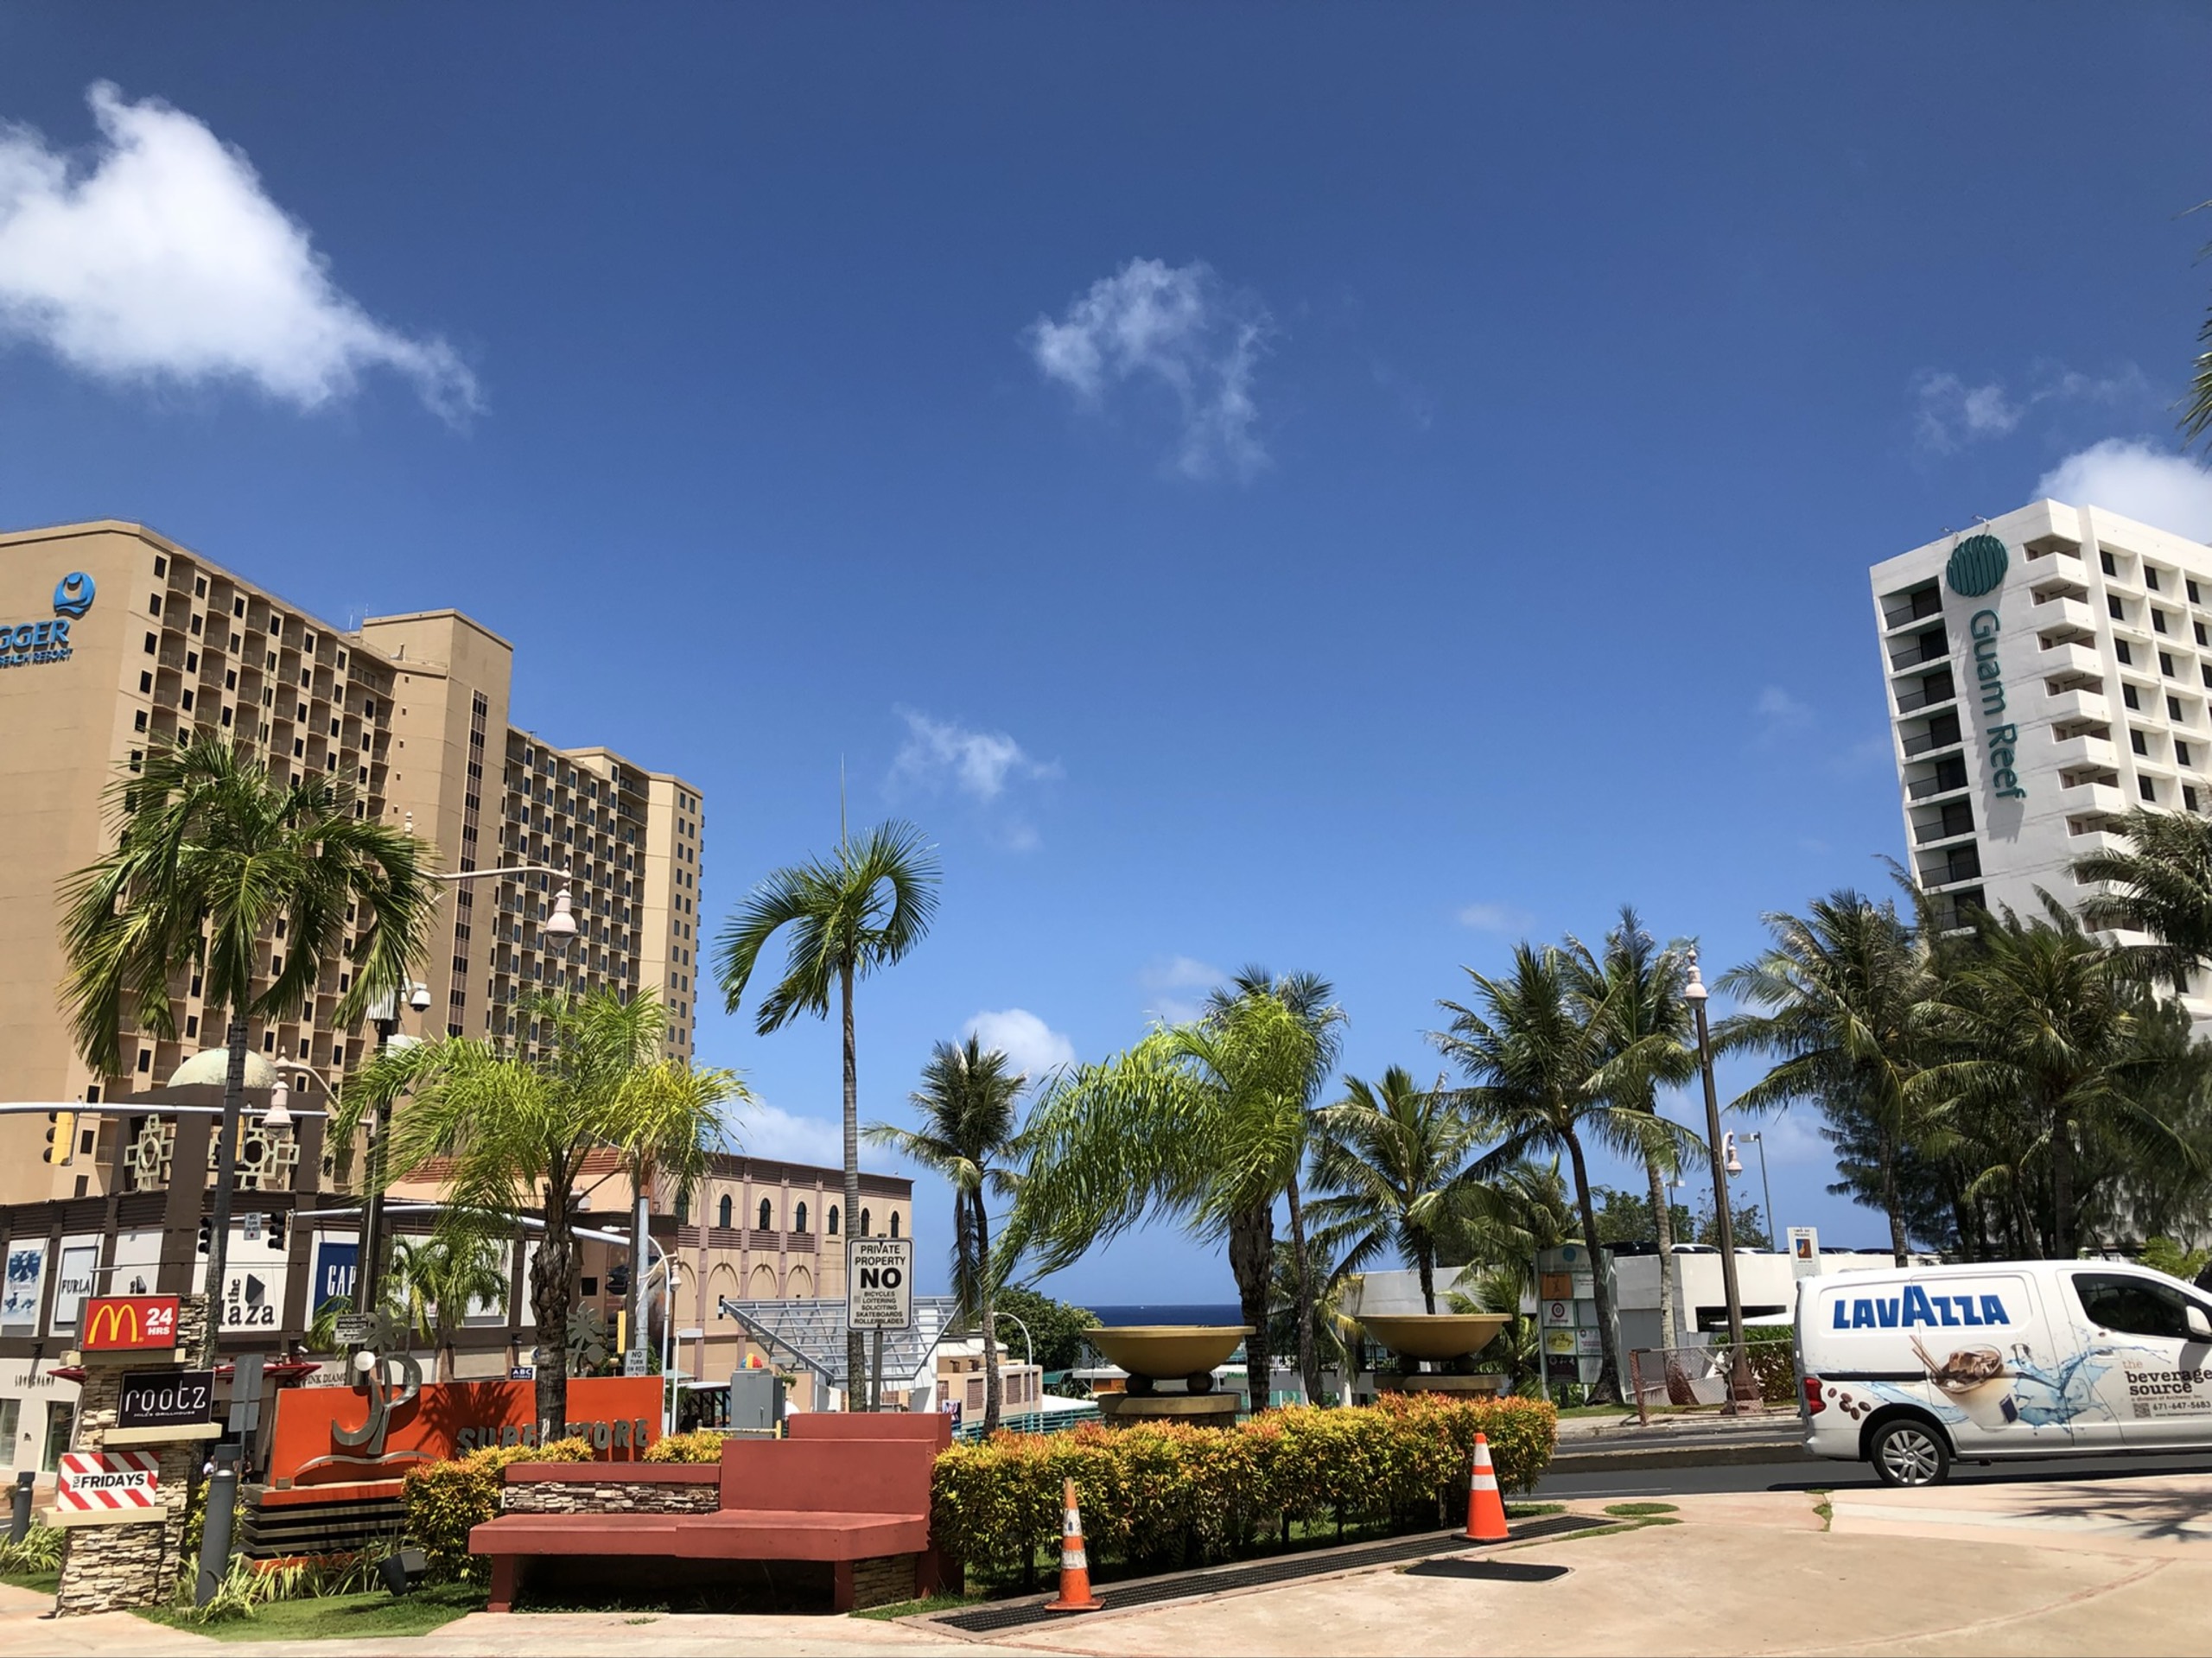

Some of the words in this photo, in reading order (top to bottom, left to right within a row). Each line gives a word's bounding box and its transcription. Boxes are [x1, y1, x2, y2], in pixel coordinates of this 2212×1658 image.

[33, 647, 73, 661] RESORT
[1970, 608, 2007, 716] Guam
[1986, 723, 2026, 801] Reef
[860, 1244, 900, 1255] PRIVATE
[855, 1255, 906, 1266] PROPERTY
[61, 1279, 90, 1294] FURLA
[327, 1265, 357, 1296] GAP
[860, 1267, 902, 1289] NO
[227, 1279, 241, 1304] the
[219, 1299, 275, 1325] laza
[1833, 1286, 2011, 1329] LAVAZZA
[146, 1307, 173, 1326] 24
[2122, 1360, 2144, 1369] the
[2124, 1369, 2212, 1384] beverage
[125, 1380, 206, 1413] rootz
[2130, 1382, 2192, 1396] source
[2152, 1401, 2211, 1411] 671-647-5683
[72, 1476, 81, 1489] TGI
[80, 1473, 145, 1489] FRIDAYS
